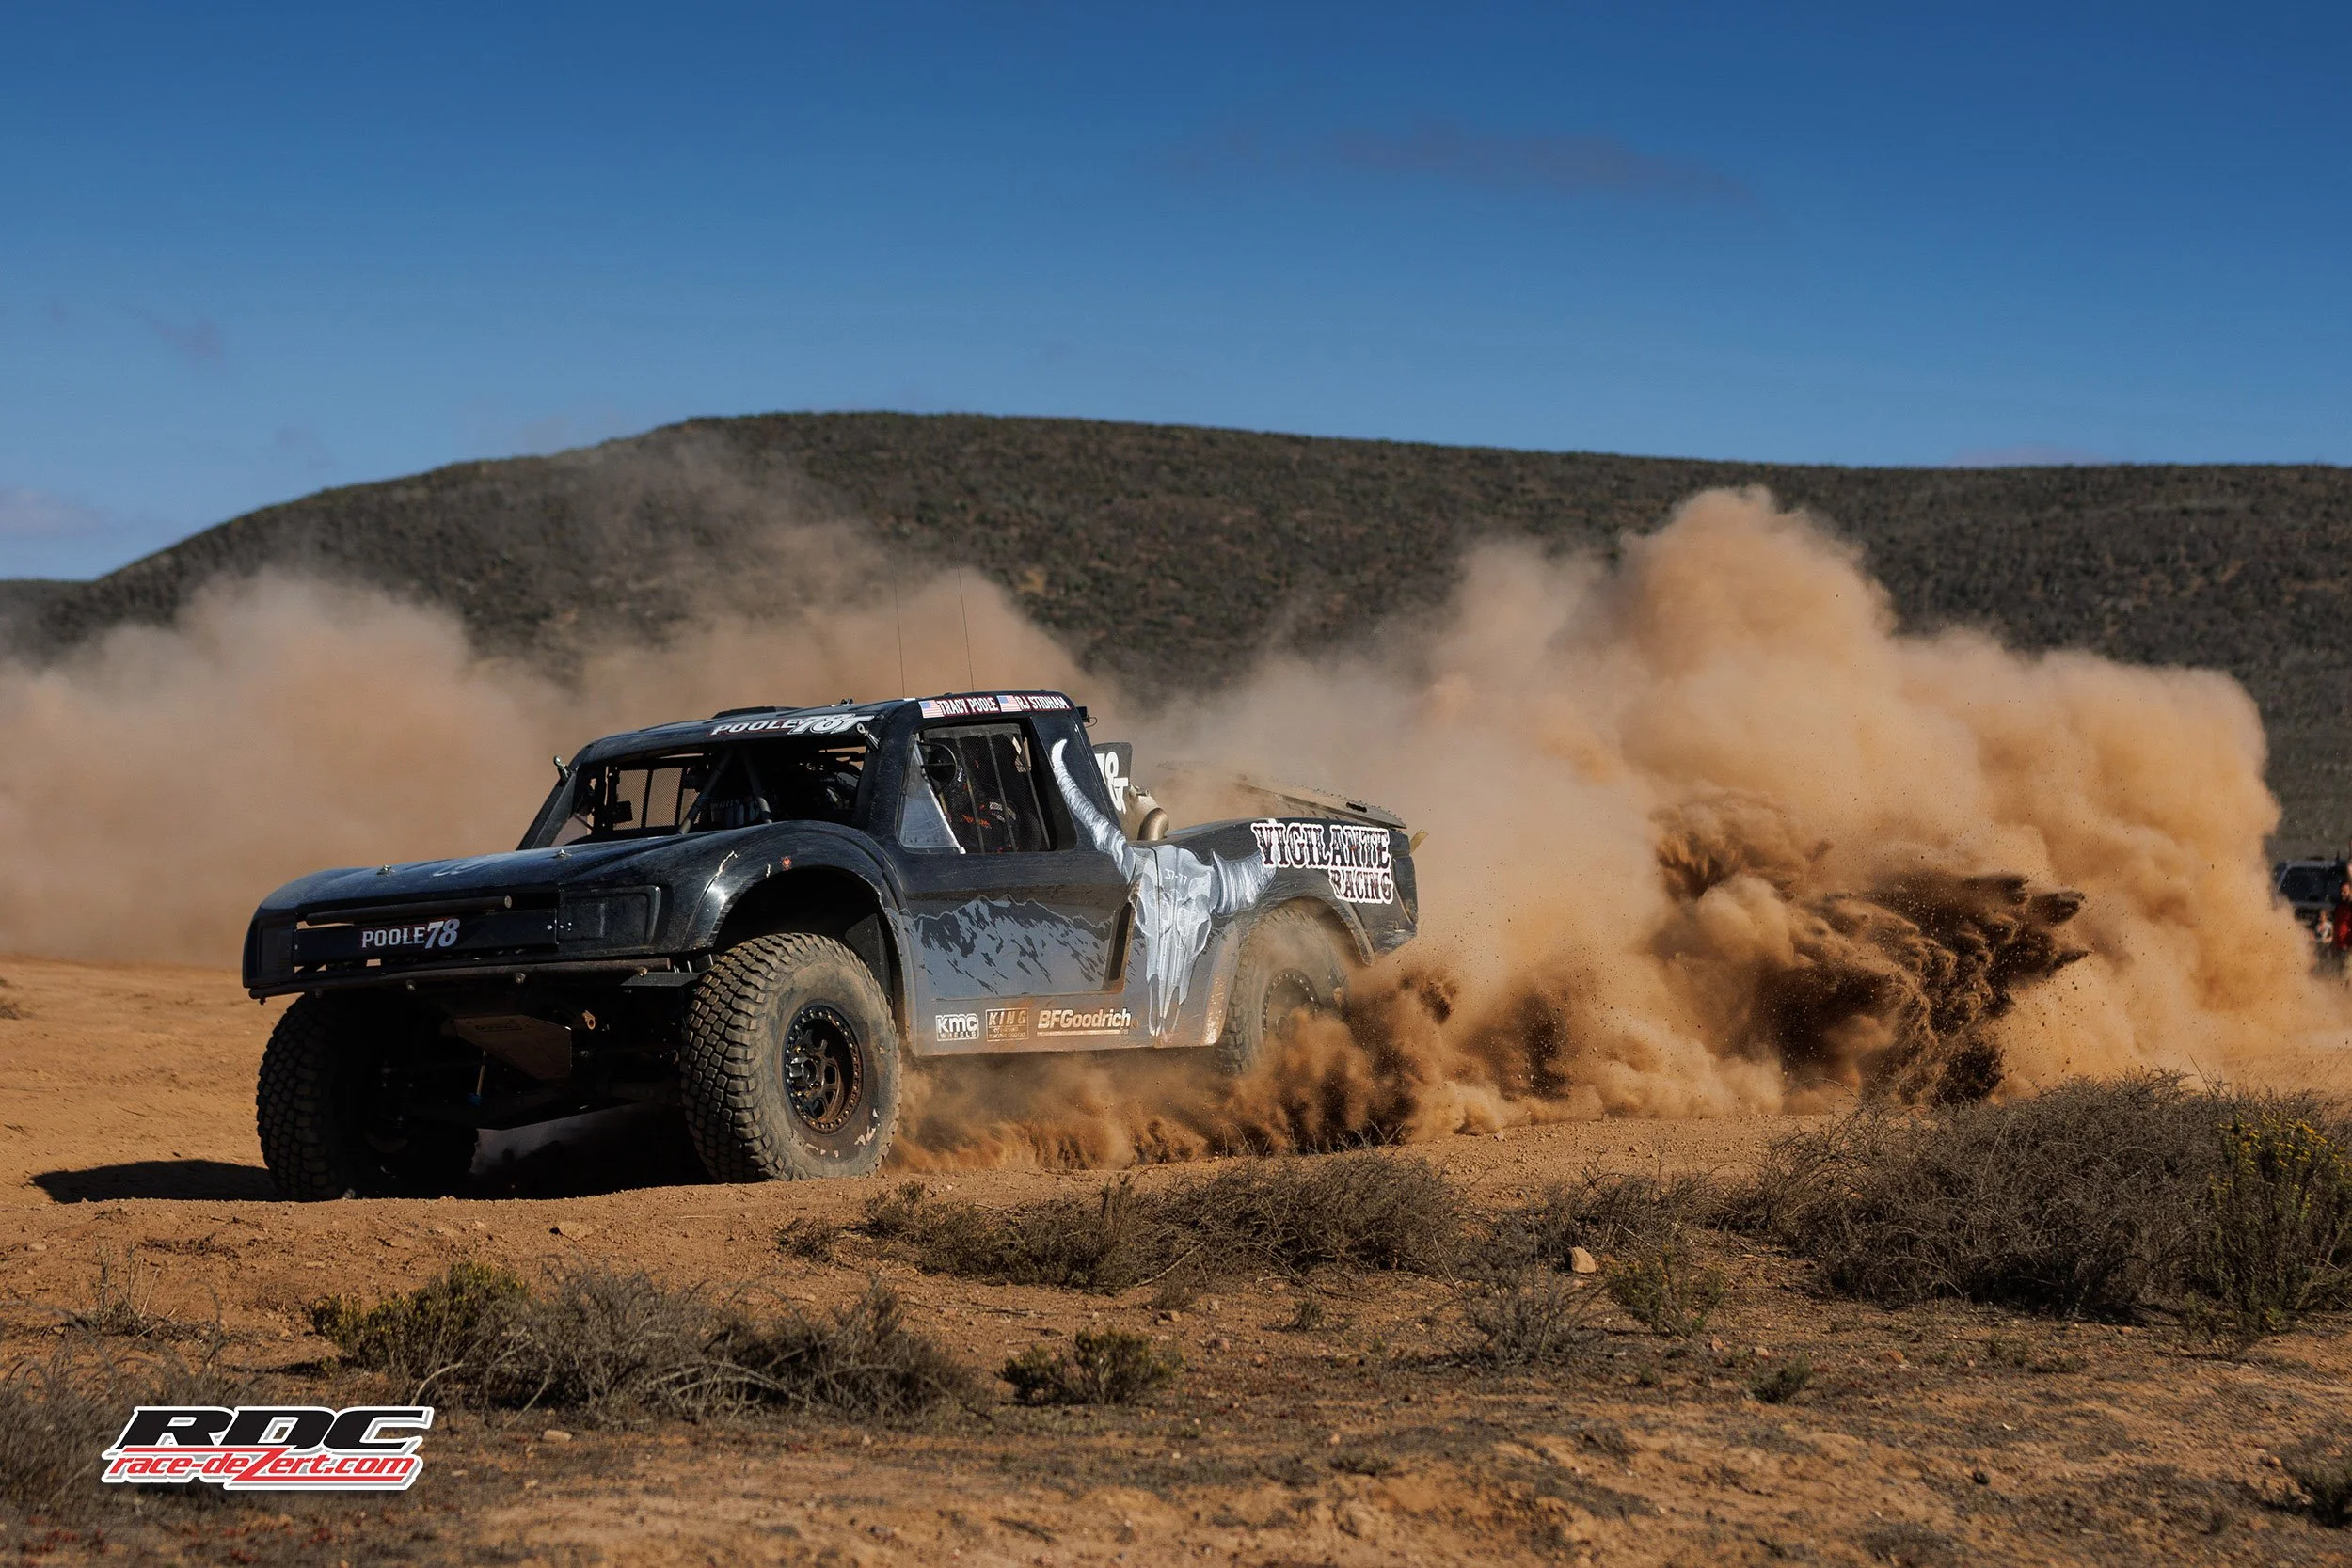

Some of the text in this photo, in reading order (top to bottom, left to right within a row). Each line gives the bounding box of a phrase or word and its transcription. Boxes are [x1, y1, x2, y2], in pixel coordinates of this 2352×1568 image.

[936, 696, 999, 716] TRACY POOLE
[1015, 695, 1071, 710] RJ STIDHAM
[1252, 824, 1391, 869] VIGILANTE
[1329, 868, 1392, 901] RACING
[988, 1010, 1027, 1026] KING
[1037, 1007, 1132, 1029] BFGoodrich
